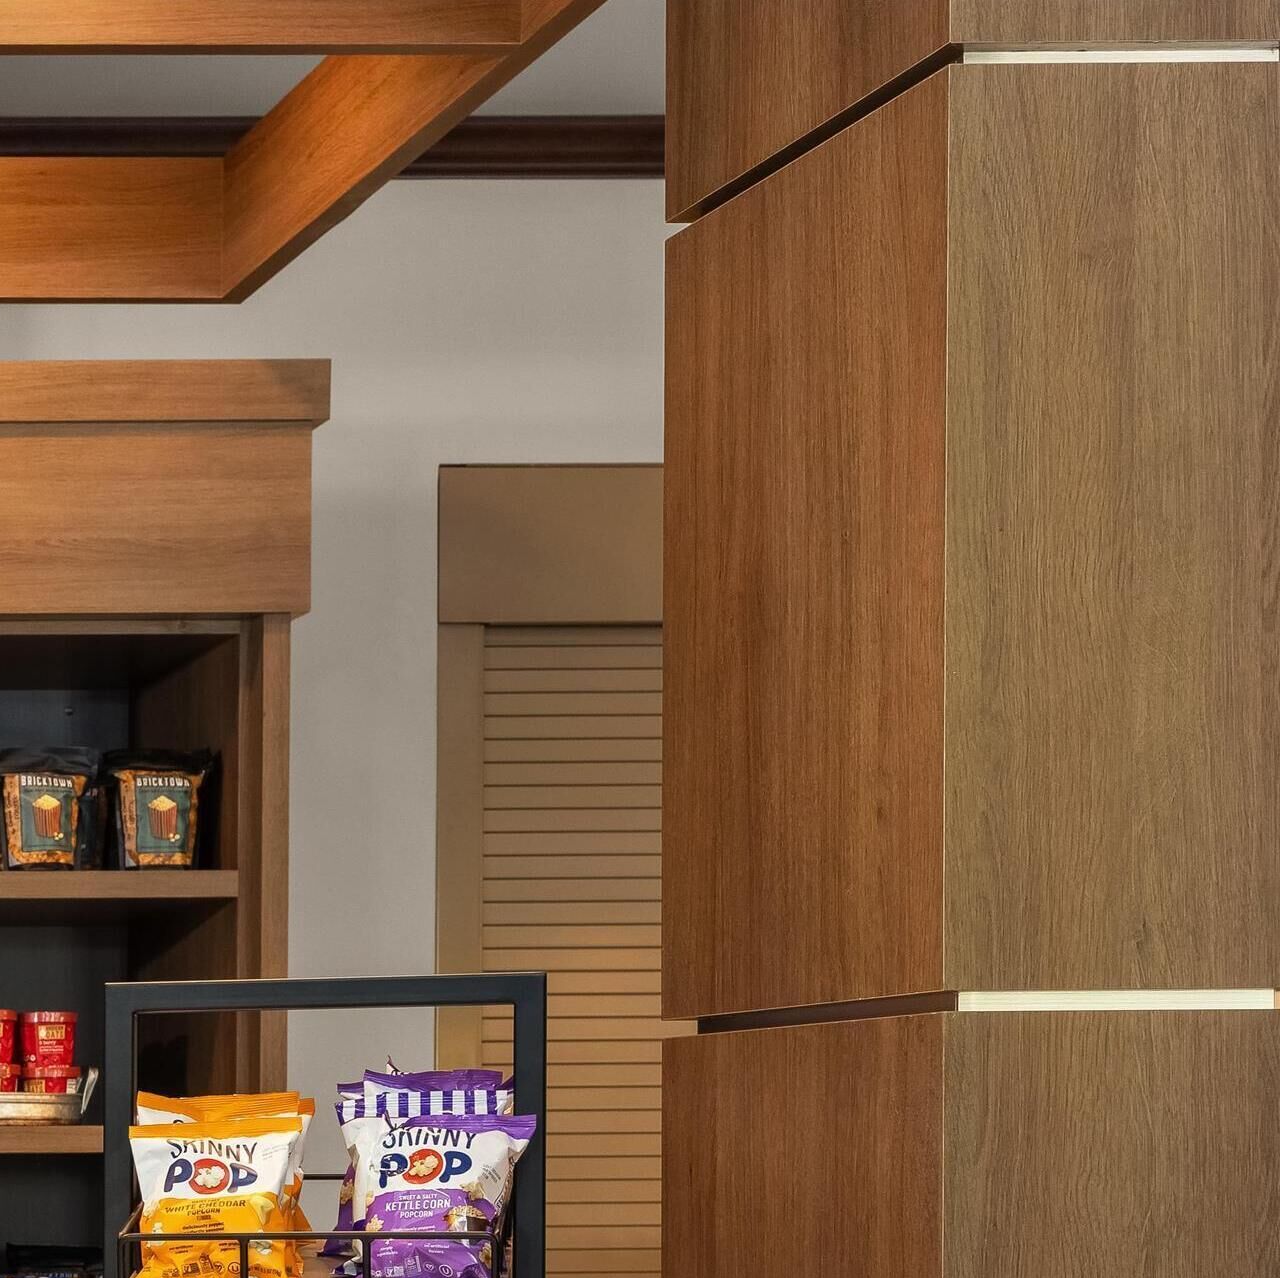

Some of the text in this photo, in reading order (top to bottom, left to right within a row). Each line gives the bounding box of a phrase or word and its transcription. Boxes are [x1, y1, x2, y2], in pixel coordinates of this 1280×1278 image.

[21, 775, 73, 787] BRICKTOWN
[166, 1138, 258, 1164] SKINNY
[379, 1148, 473, 1188] POP
[163, 1158, 258, 1194] POP
[165, 1203, 197, 1214] WHITE
[198, 1199, 246, 1208] CHEDDAR
[187, 1208, 221, 1216] POPCORN
[385, 1199, 451, 1212] KETTLE CORN
[399, 1210, 434, 1219] POPCORN
